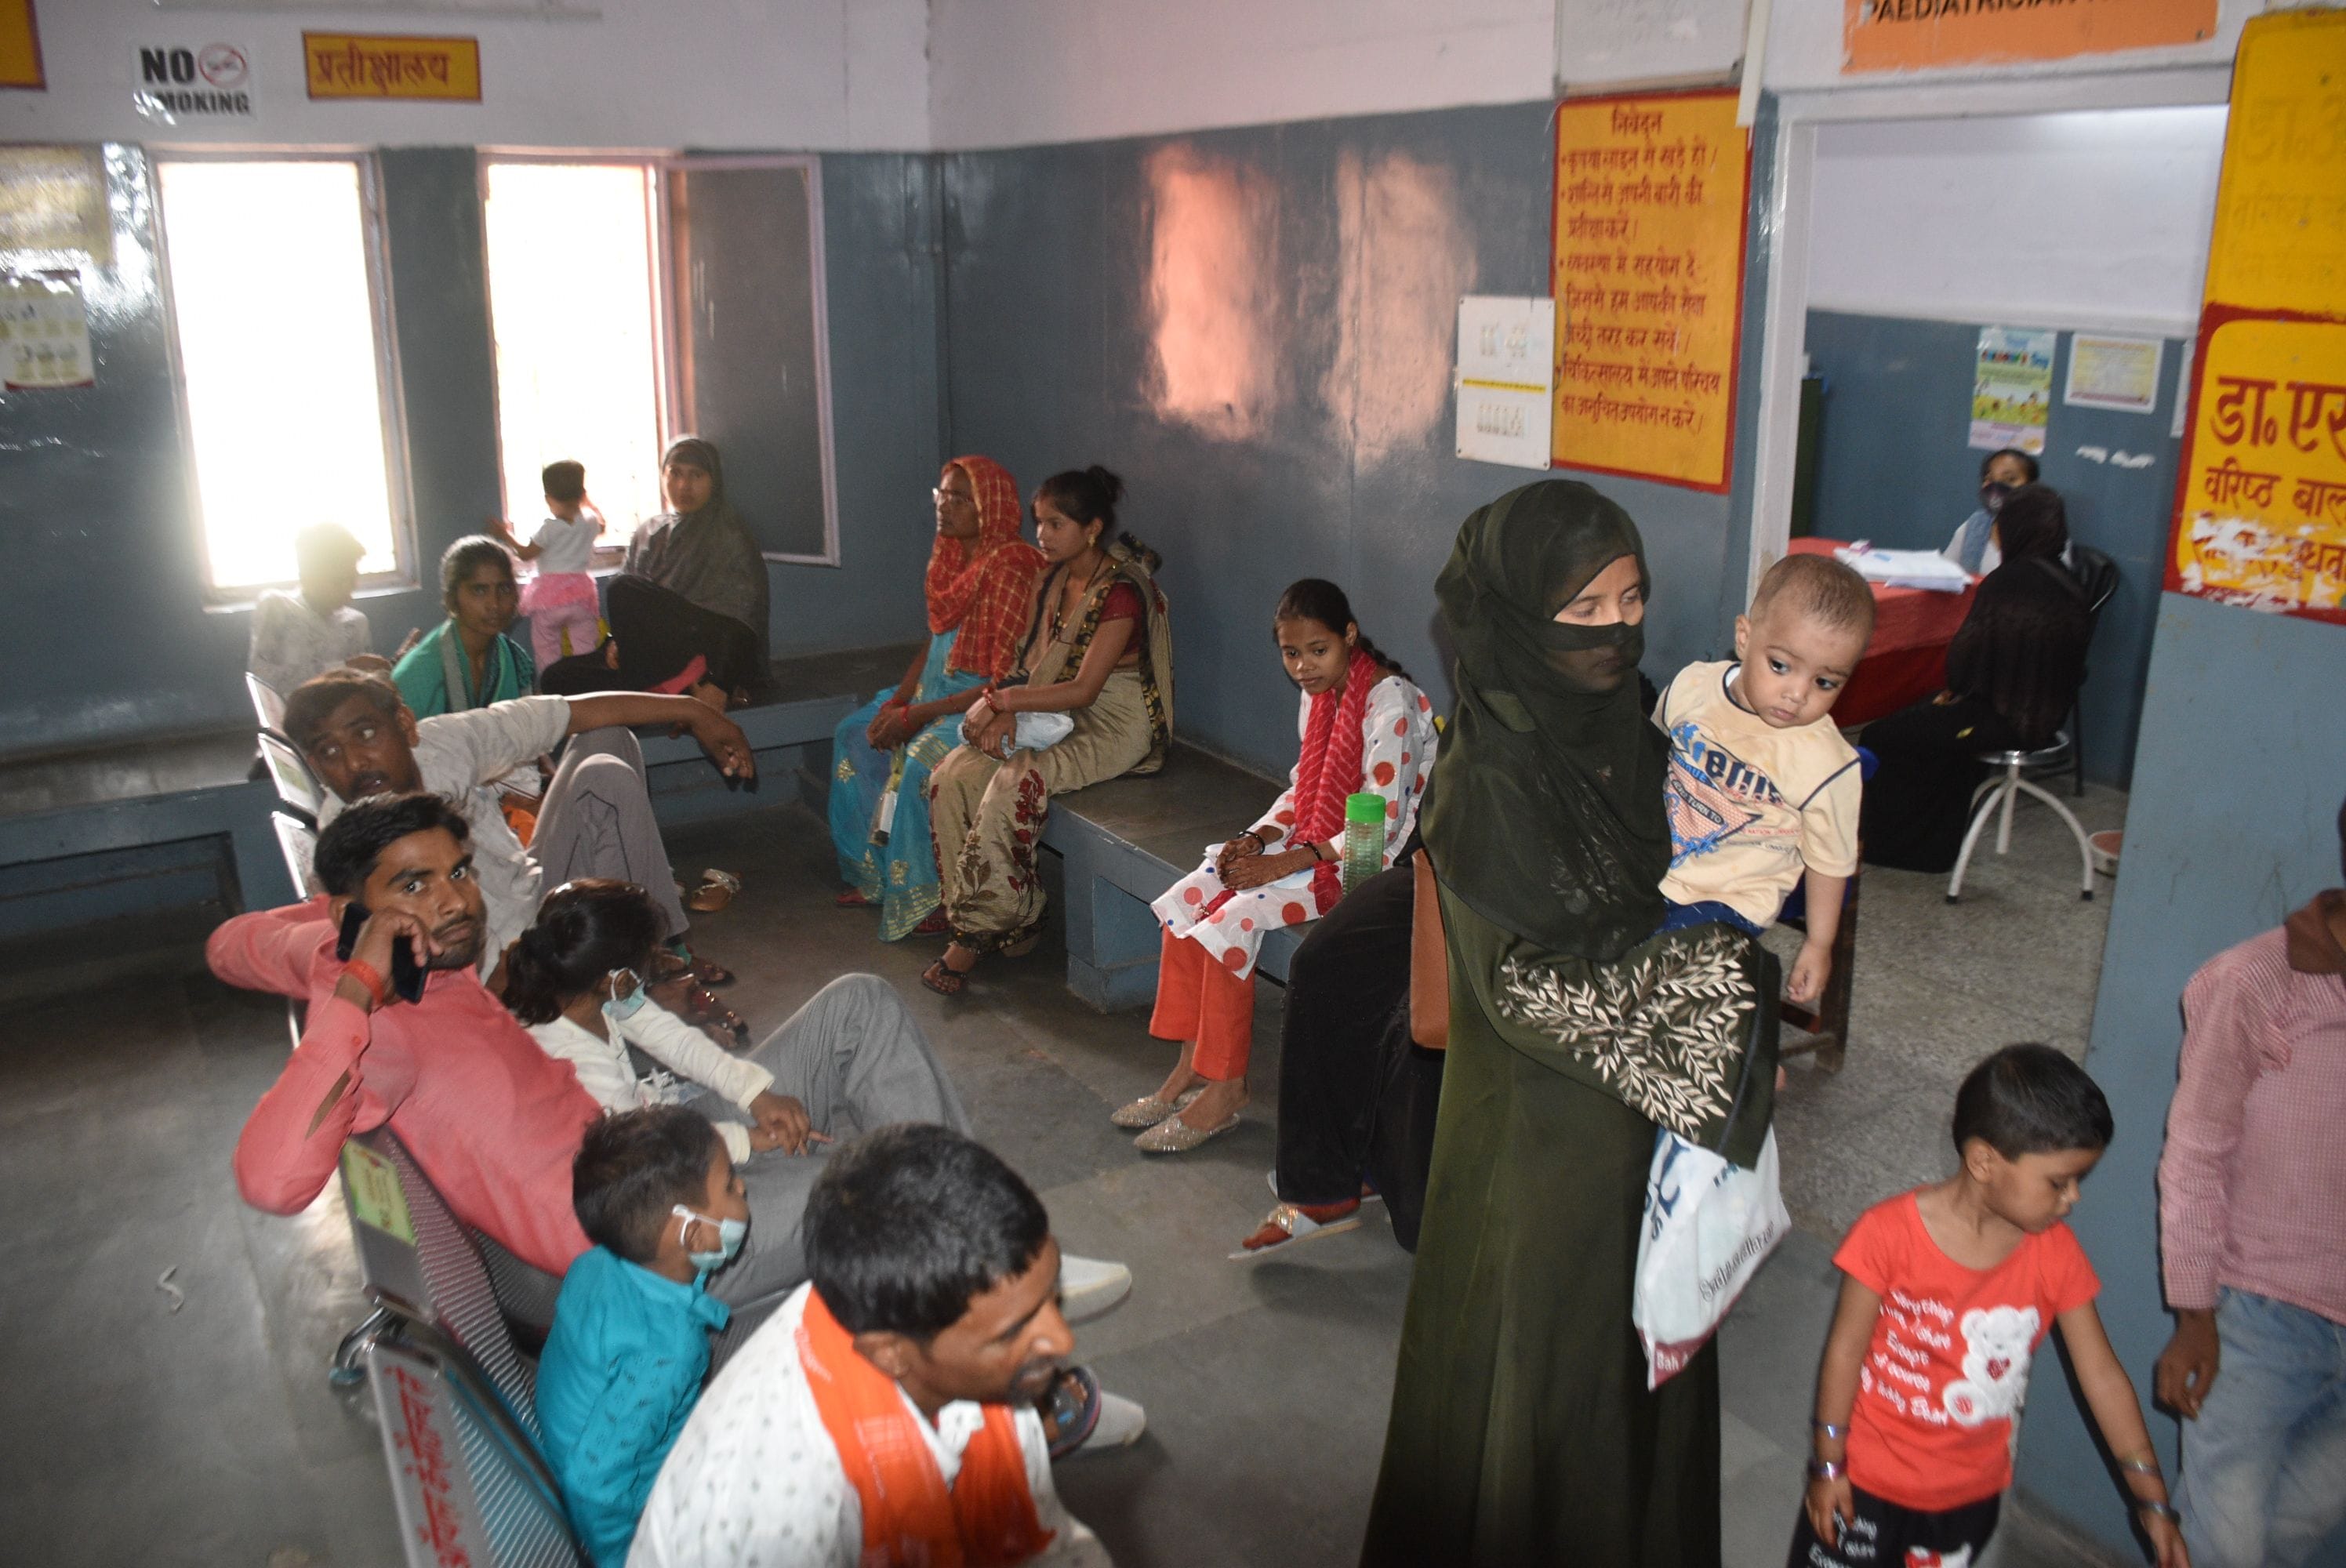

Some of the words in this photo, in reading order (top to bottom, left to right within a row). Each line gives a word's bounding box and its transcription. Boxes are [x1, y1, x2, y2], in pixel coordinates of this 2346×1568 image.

[140, 47, 195, 84] NO
[138, 89, 250, 114] MOKING
[2203, 456, 2282, 510] वरिष्ठ
[1686, 795, 1709, 817] TURN
[1708, 810, 1722, 824] TO
